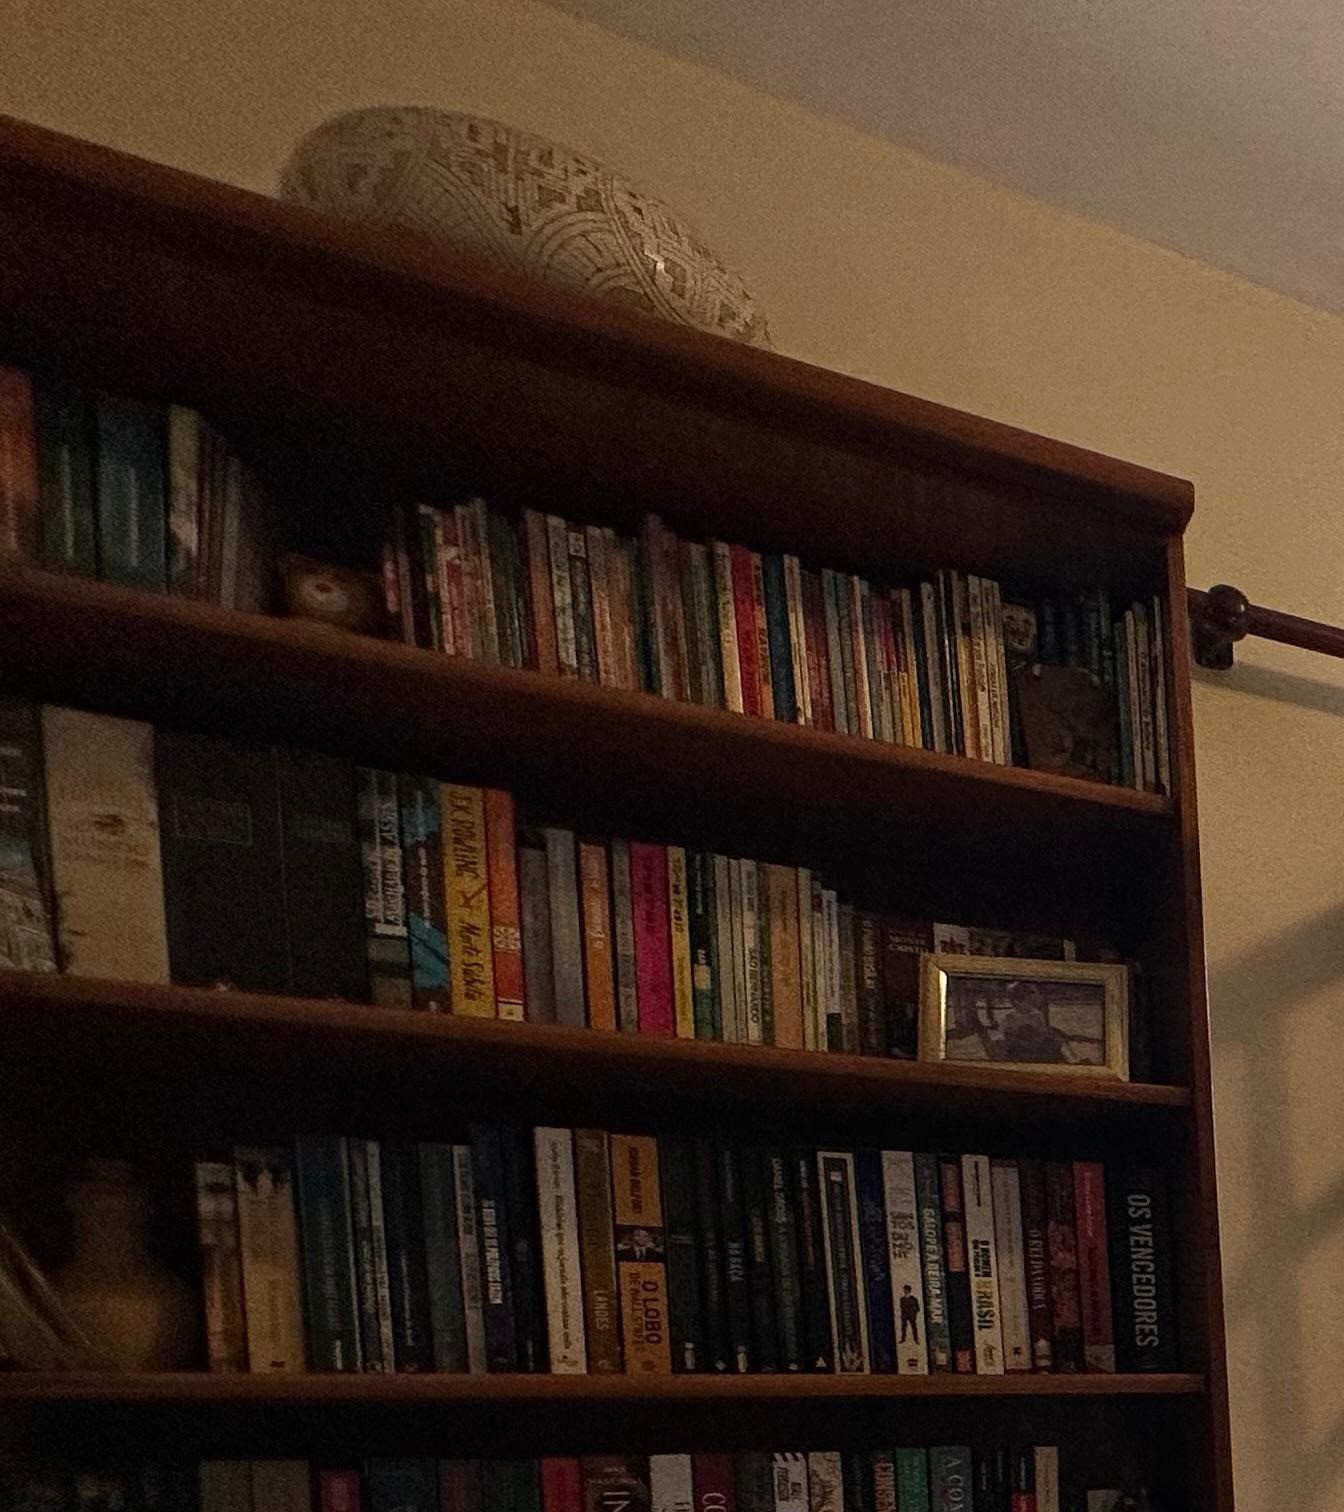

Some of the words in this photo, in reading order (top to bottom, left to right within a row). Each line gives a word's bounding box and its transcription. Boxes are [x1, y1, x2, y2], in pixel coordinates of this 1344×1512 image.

[1127, 1194, 1151, 1218] OS
[923, 1208, 938, 1252] GALOPE
[642, 1280, 659, 1293] O
[1129, 1224, 1160, 1347] VENCEDORES
[644, 1298, 662, 1345] LOBO
[946, 1456, 960, 1468] A
